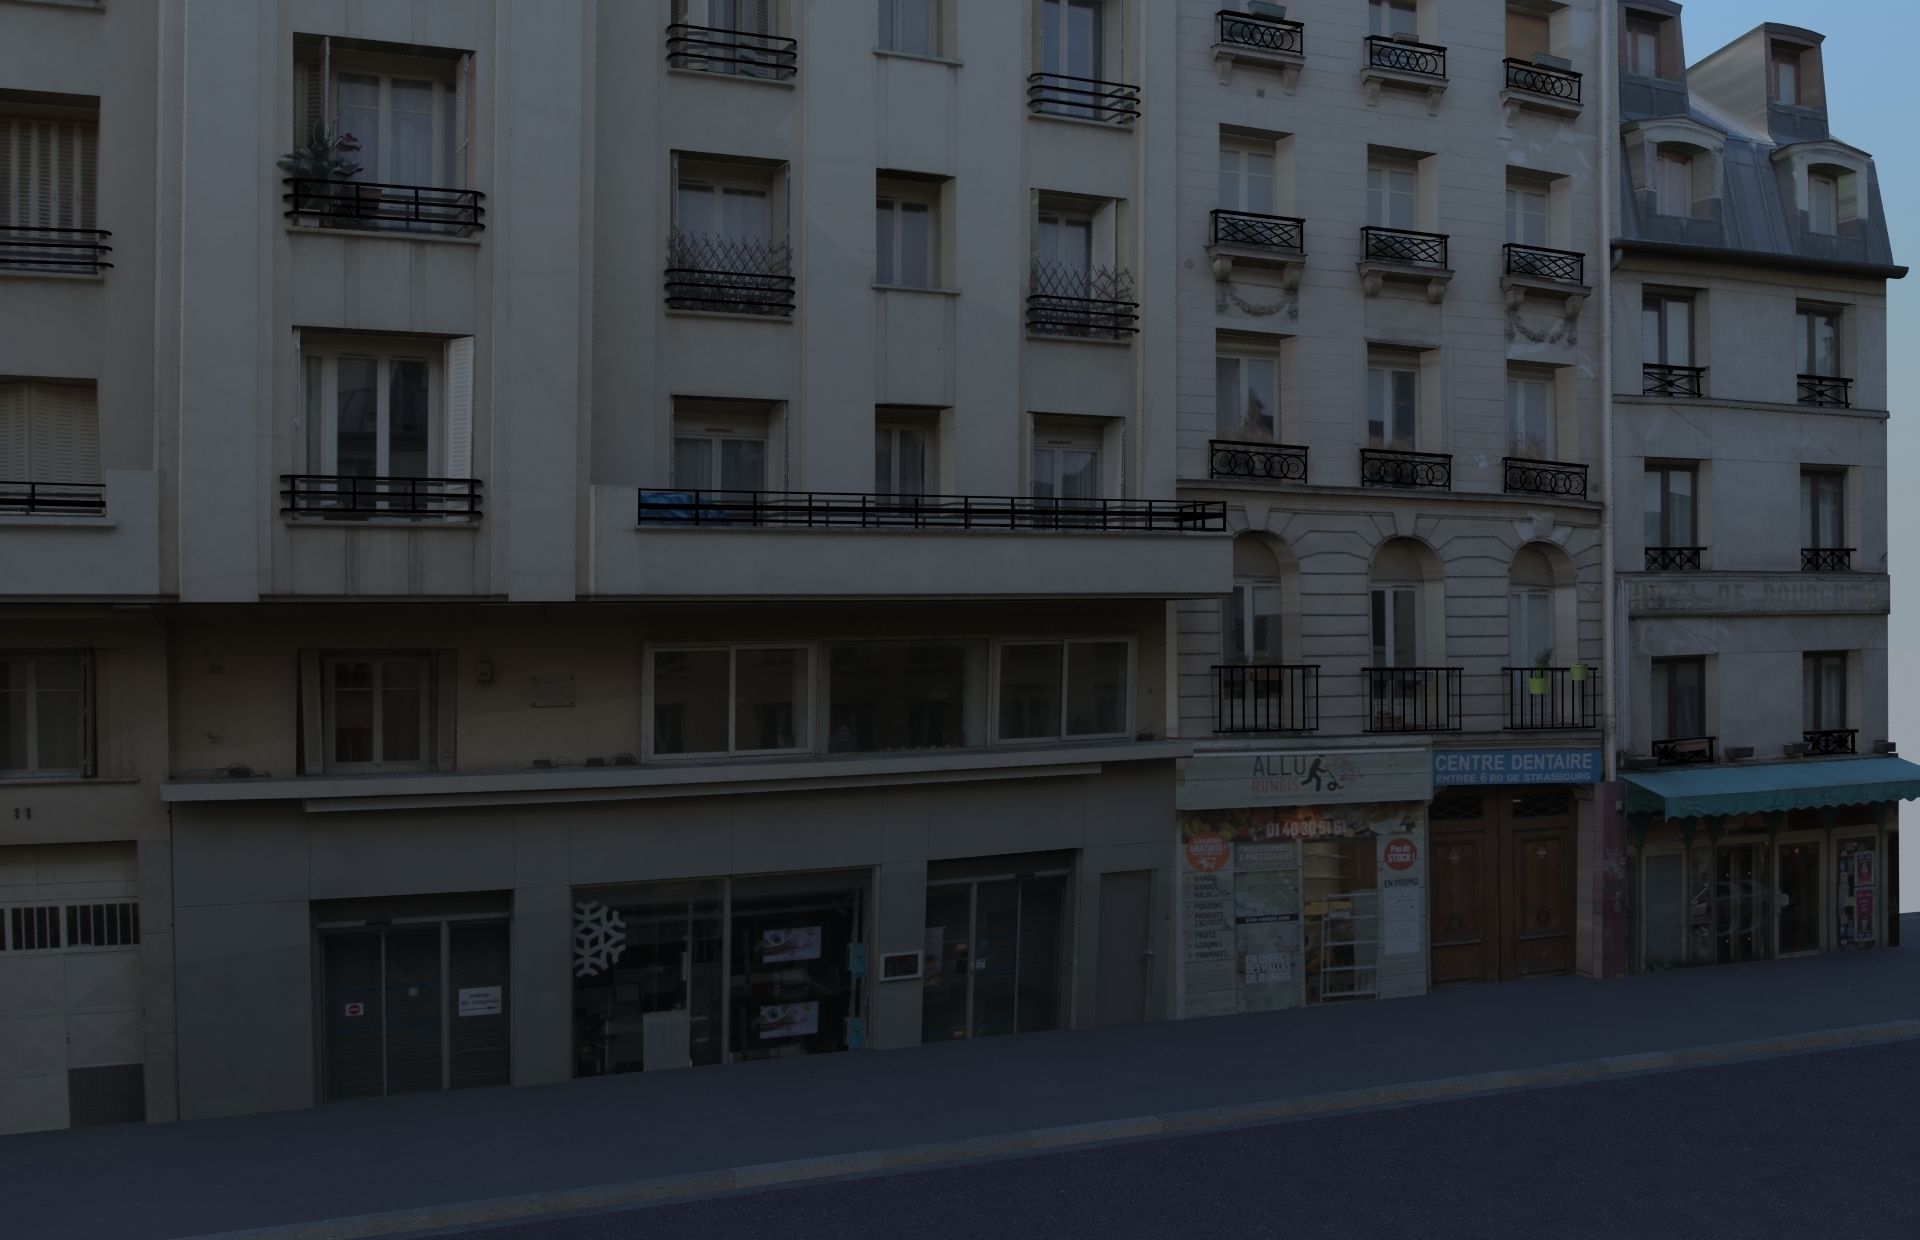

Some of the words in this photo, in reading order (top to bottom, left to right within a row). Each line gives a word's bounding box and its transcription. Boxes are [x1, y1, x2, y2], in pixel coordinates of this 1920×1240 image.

[1435, 754, 1505, 772] CENTRE
[1511, 753, 1593, 771] DENTAIRE
[1480, 772, 1488, 783] 6
[1506, 774, 1521, 783] DE
[1522, 772, 1591, 782] STRASBOURG
[1252, 778, 1301, 793] RUNGIS
[14, 807, 32, 820] 11
[1266, 822, 1280, 837] 01
[1394, 878, 1419, 888] PROMO
